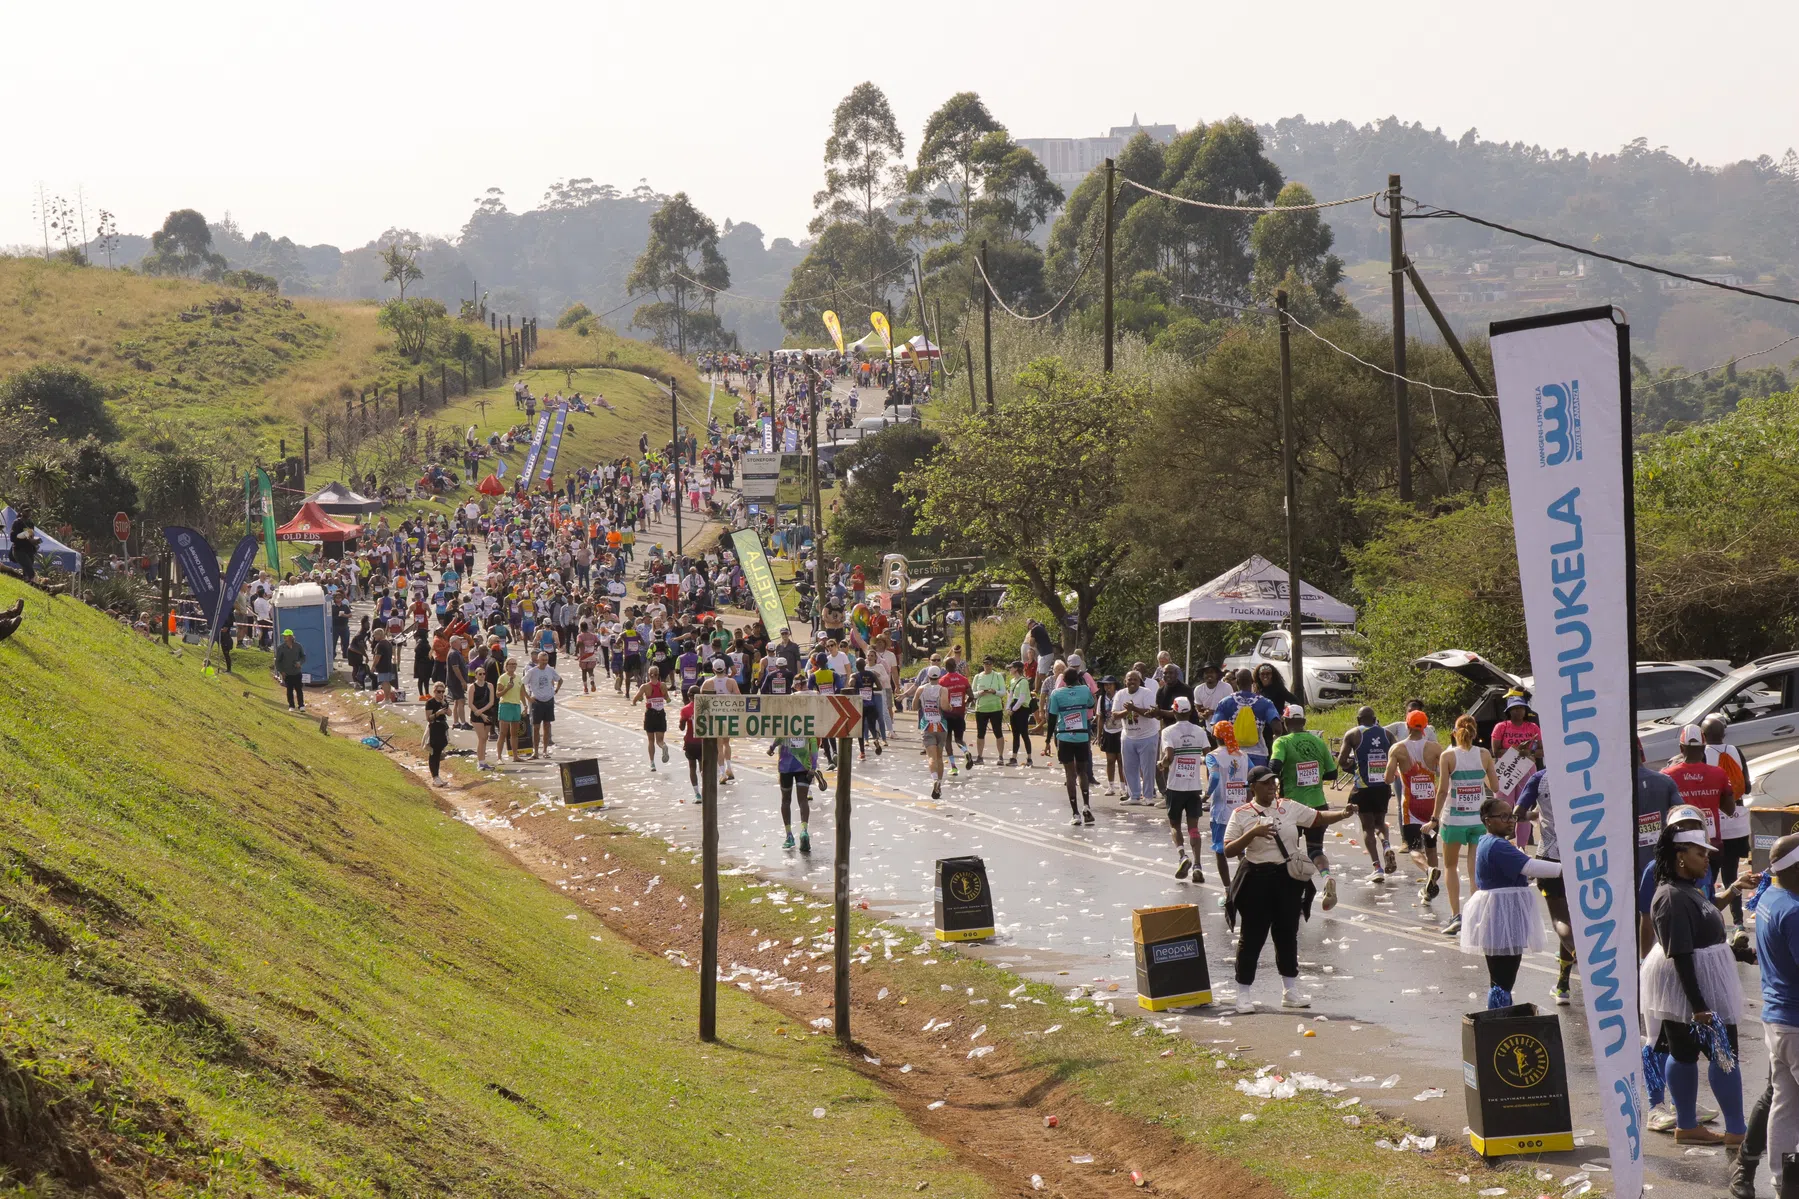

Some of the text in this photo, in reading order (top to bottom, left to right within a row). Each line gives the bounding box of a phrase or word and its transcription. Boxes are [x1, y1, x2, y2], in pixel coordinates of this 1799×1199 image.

[1535, 386, 1546, 468] UMNGENI-UTHUKELA
[115, 522, 130, 532] STOP
[283, 532, 320, 540] OLD EDS
[908, 563, 959, 576] verstone 1
[1230, 607, 1255, 615] Truck
[696, 715, 815, 736] SITE OFFICE
[1547, 486, 1627, 1058] UMNGENI-UTHUKELA
[1683, 772, 1704, 782] Vitality
[1691, 789, 1720, 797] VITALITY
[1155, 943, 1192, 958] neopak
[1497, 1037, 1535, 1057] COMRADES
